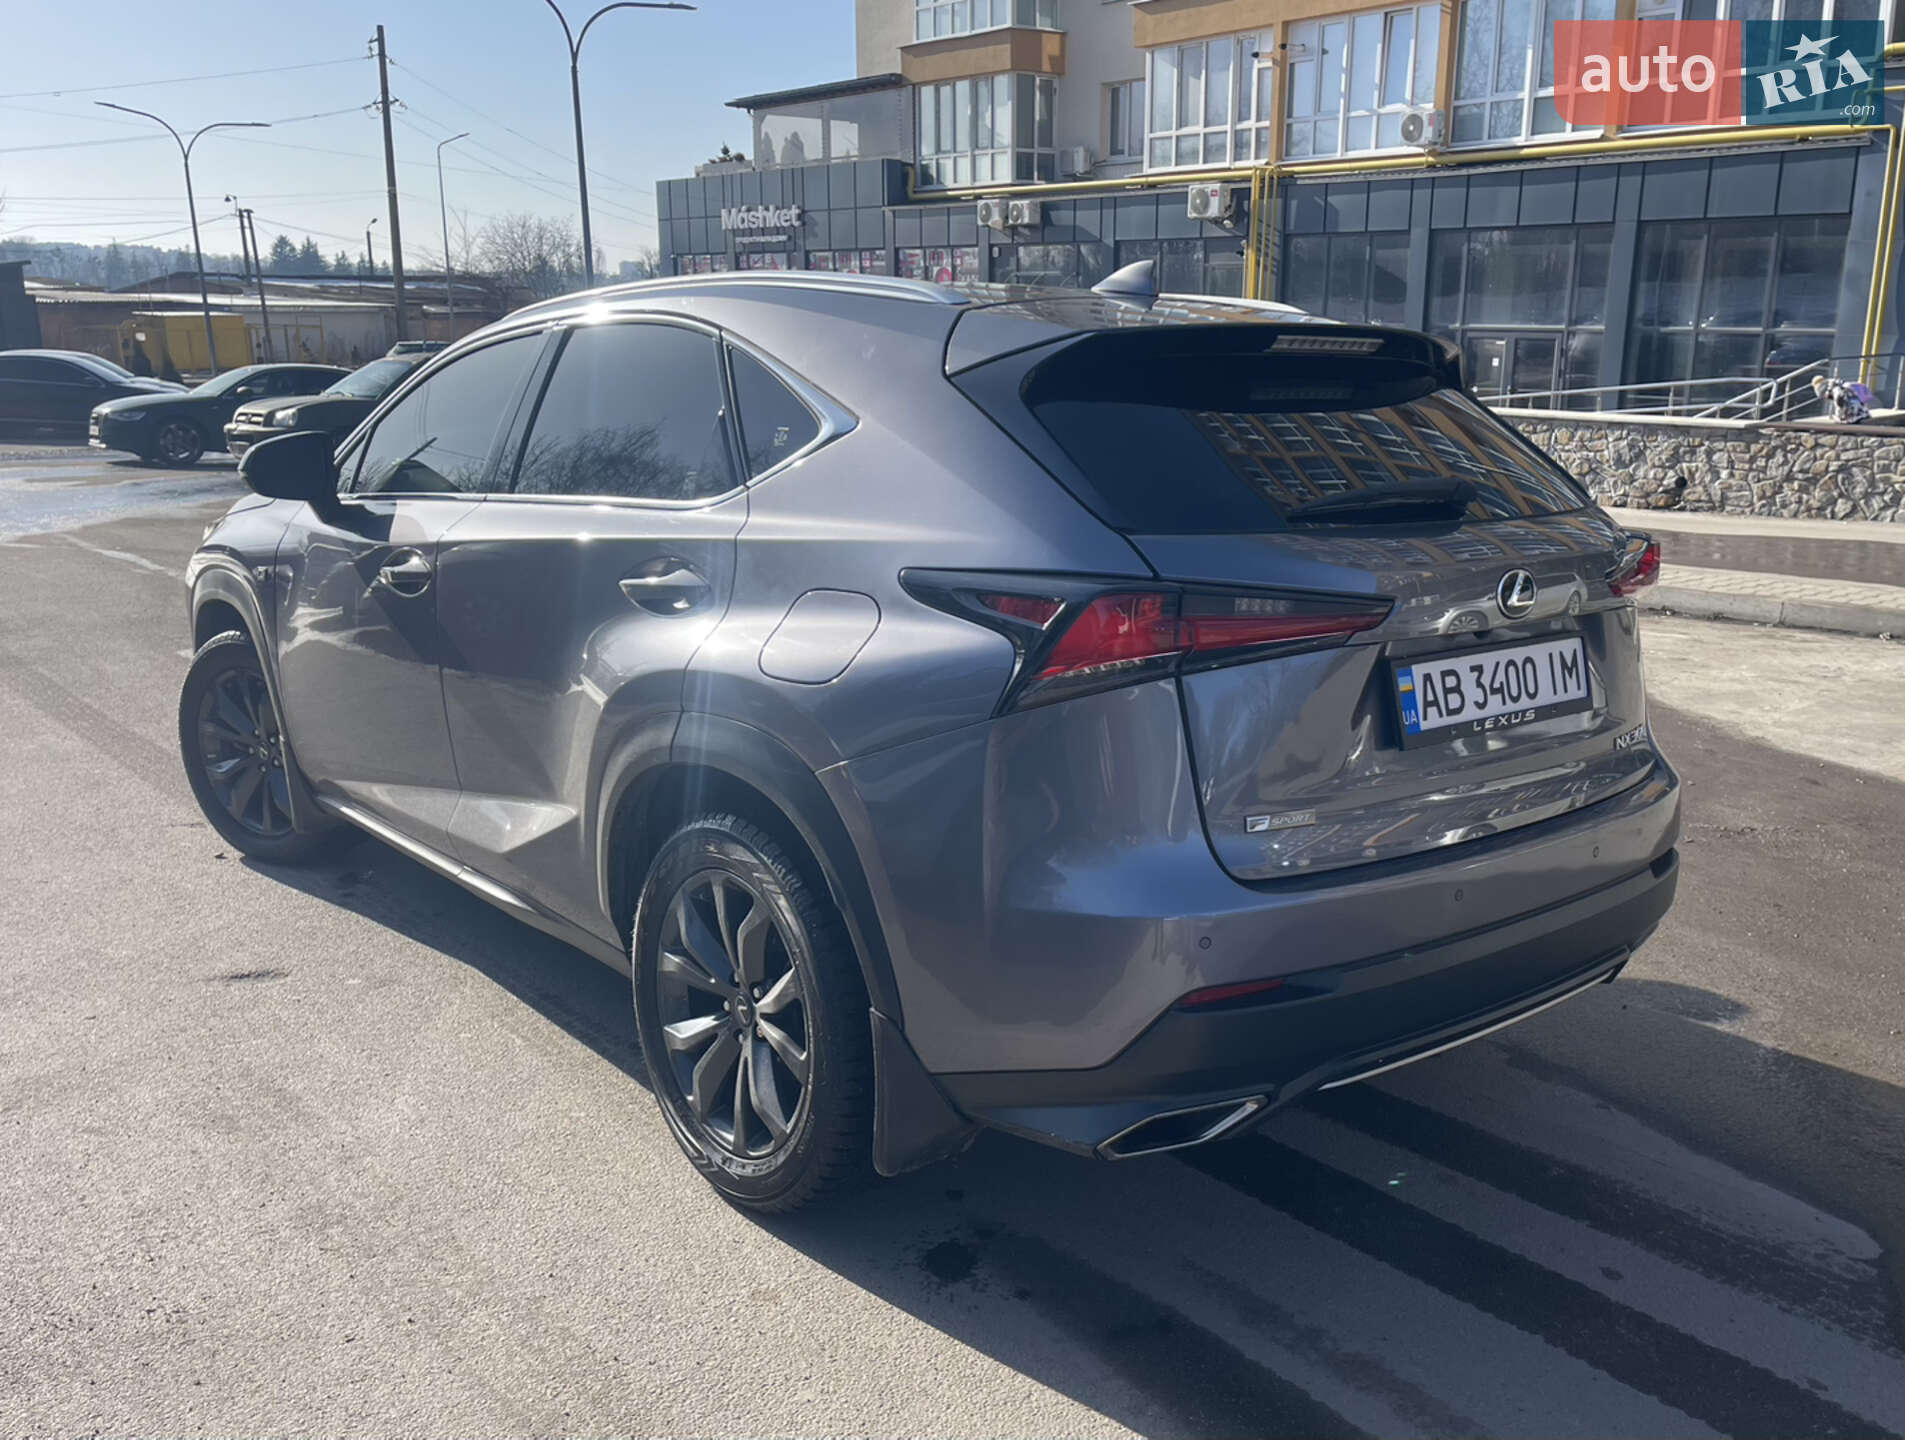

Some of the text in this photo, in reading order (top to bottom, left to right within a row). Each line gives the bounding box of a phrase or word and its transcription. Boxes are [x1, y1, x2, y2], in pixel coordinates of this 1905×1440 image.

[1422, 647, 1582, 721] AB 3400 IM
[1402, 709, 1418, 725] UA
[1473, 709, 1537, 731] LEXUS
